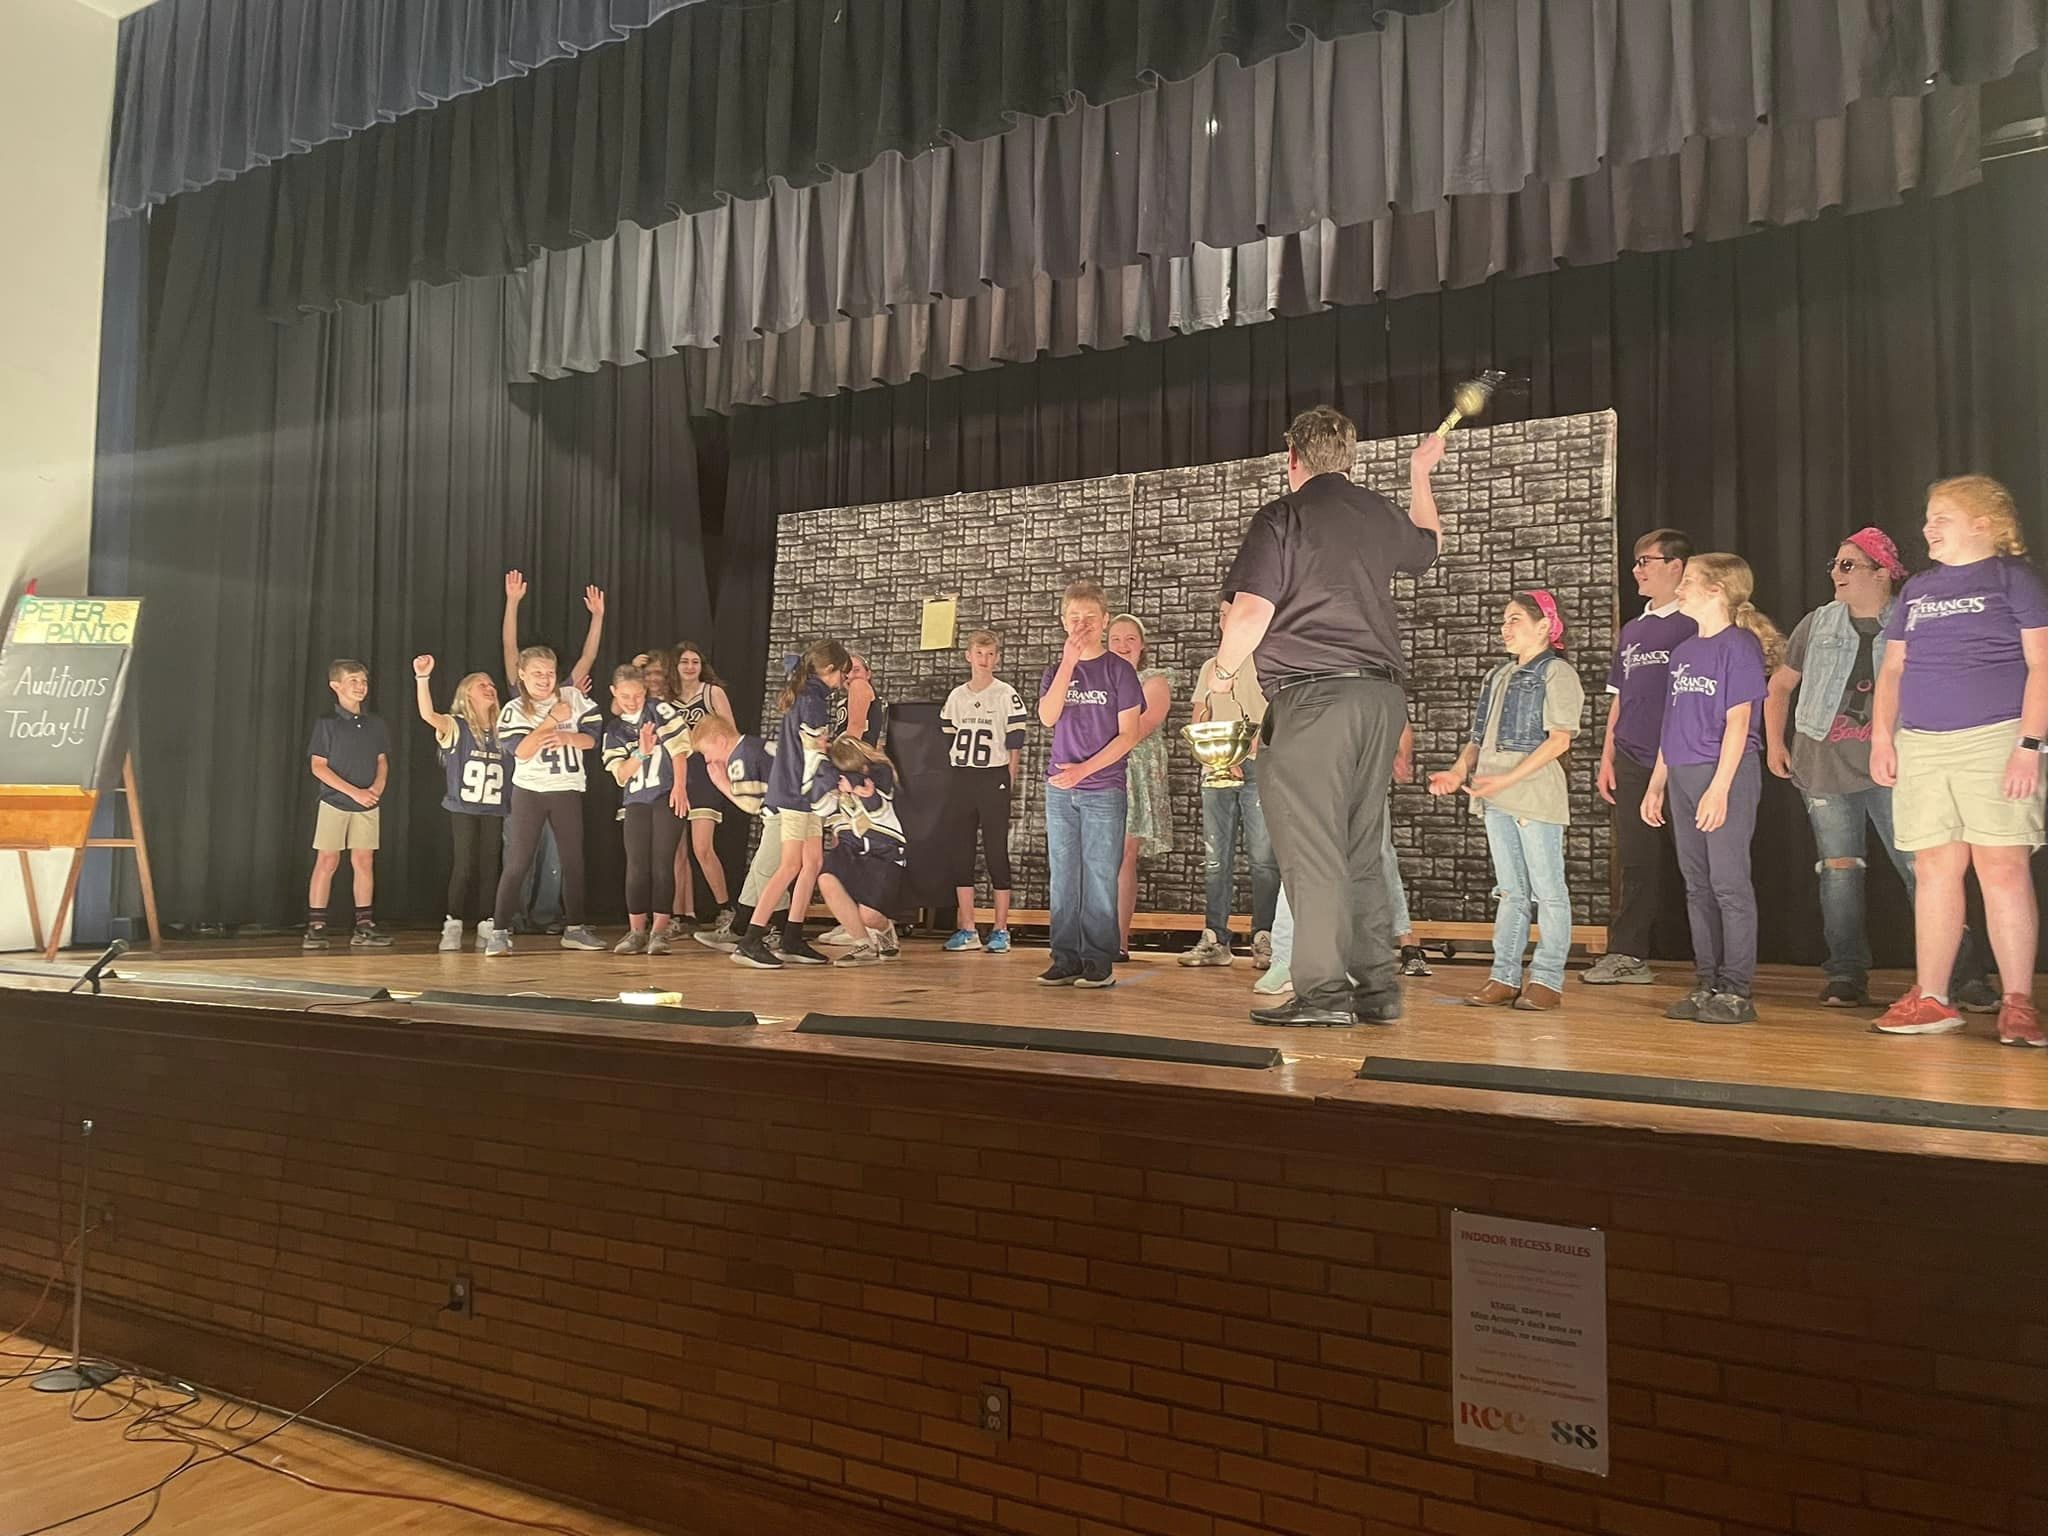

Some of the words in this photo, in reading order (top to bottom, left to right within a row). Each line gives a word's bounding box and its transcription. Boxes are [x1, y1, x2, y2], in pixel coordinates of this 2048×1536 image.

[20, 601, 106, 623] PETER
[46, 622, 129, 643] PANIC
[12, 665, 109, 698] Auditions
[4, 706, 91, 748] Today!!
[540, 744, 580, 774] 40
[955, 728, 993, 767] 96
[460, 760, 504, 805] 92
[1460, 1230, 1507, 1246] INDOOR
[1509, 1236, 1552, 1252] RECESS
[1554, 1243, 1592, 1258] RULES
